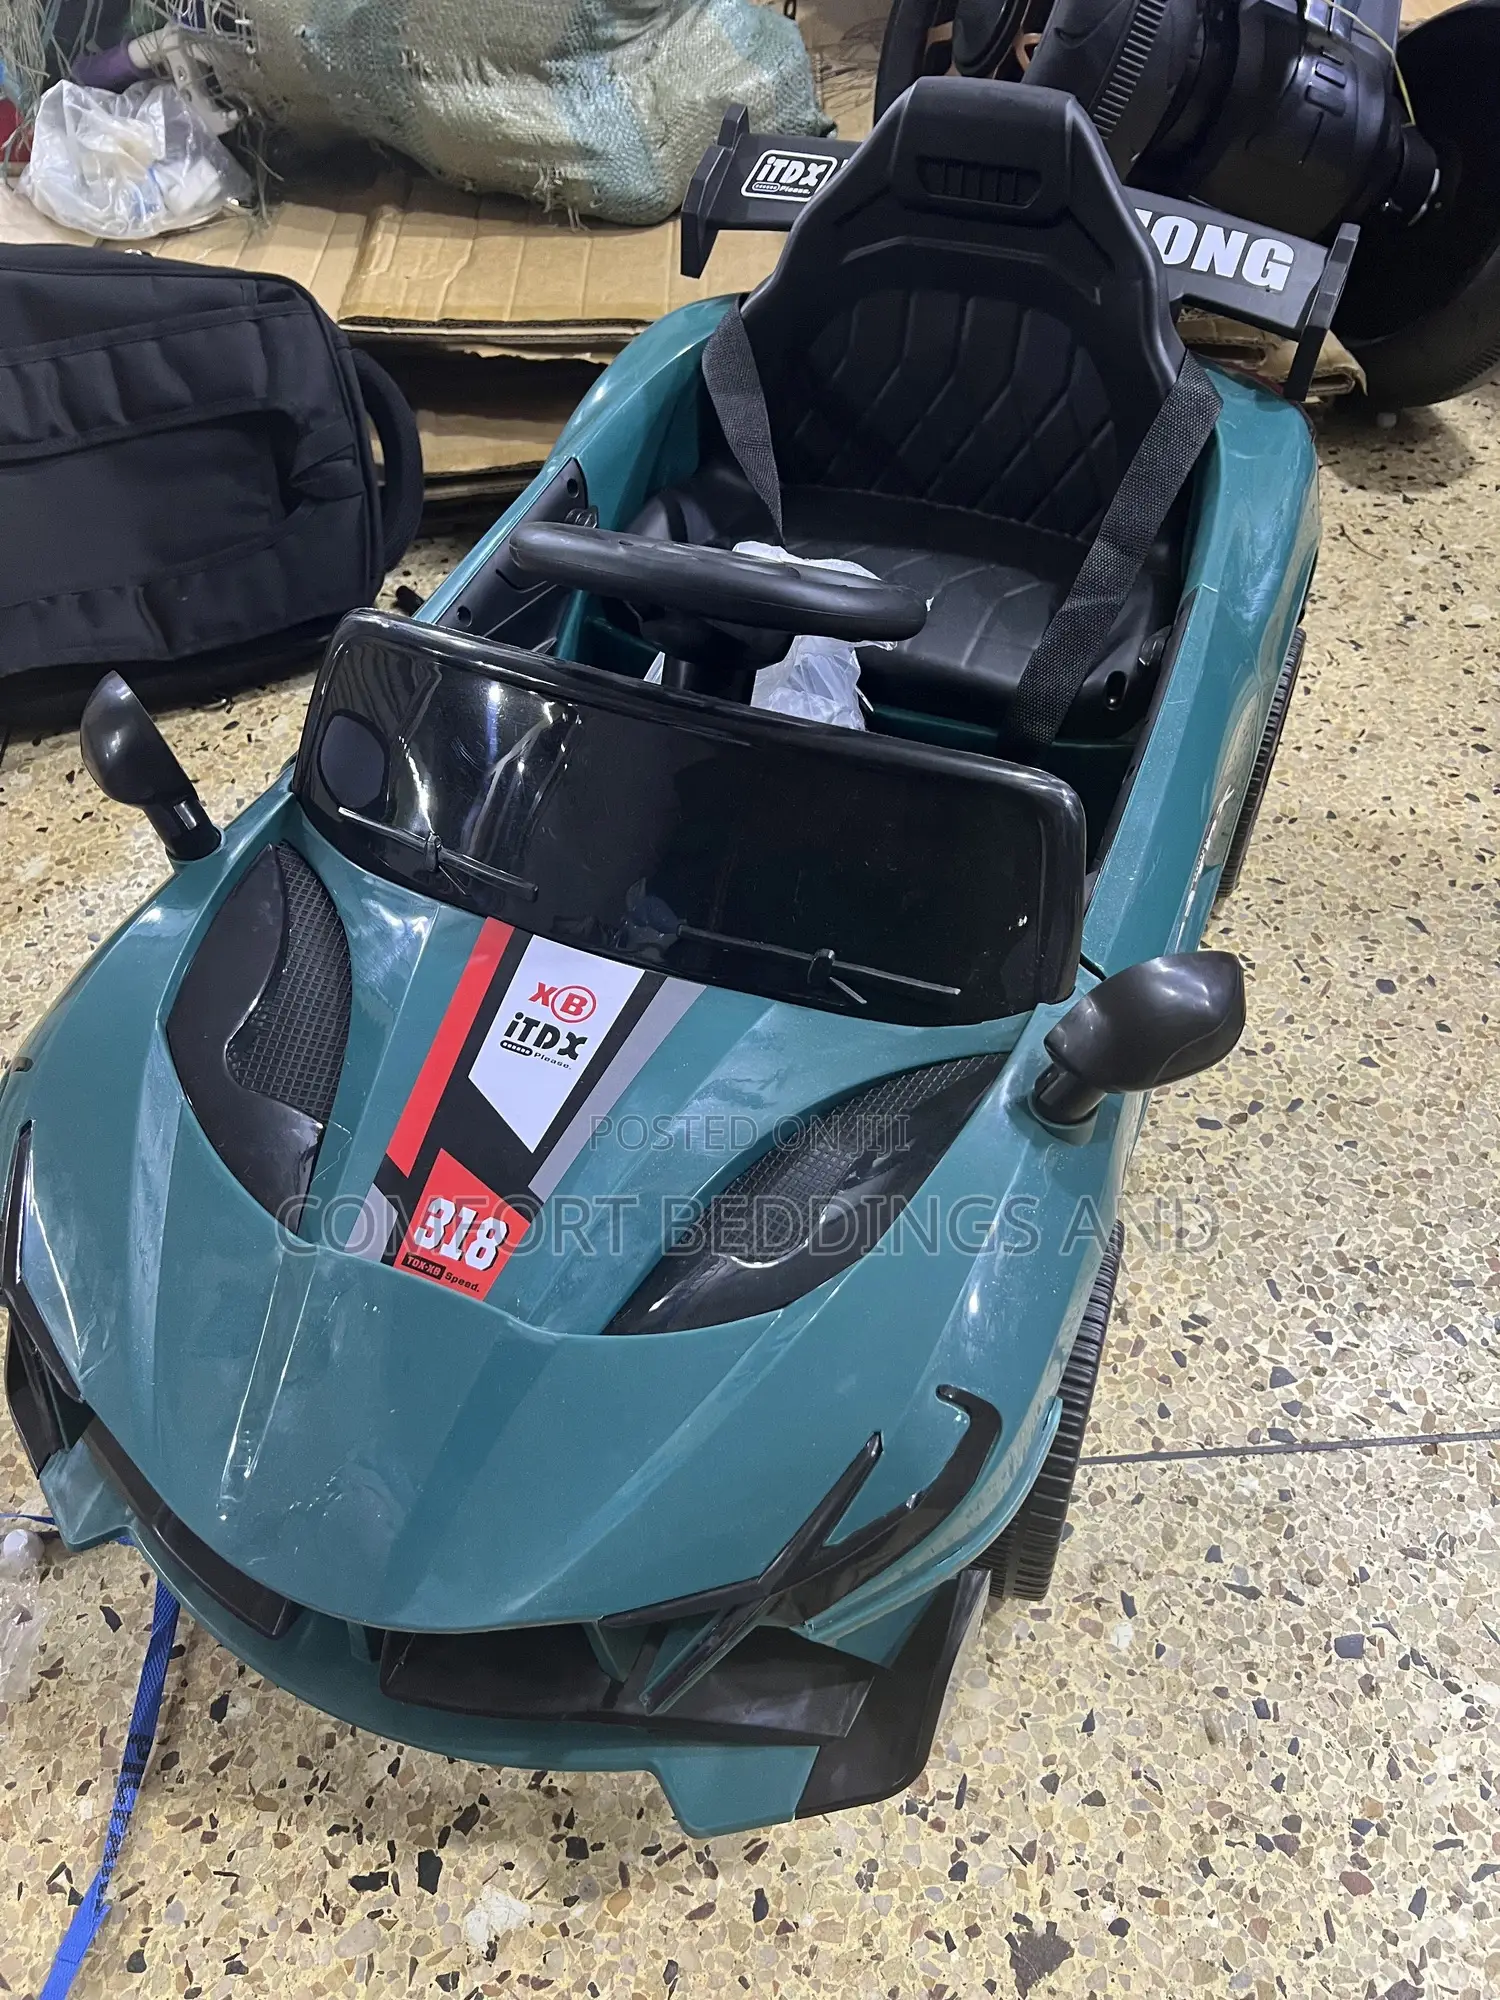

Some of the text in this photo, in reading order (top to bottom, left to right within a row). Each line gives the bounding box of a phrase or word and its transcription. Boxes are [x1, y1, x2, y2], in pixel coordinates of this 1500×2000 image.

[756, 156, 828, 187] iTDX
[1134, 207, 1295, 292] ONG
[504, 1011, 588, 1061] iTDX
[413, 1196, 510, 1272] 318
[444, 1271, 480, 1293] Speed.
